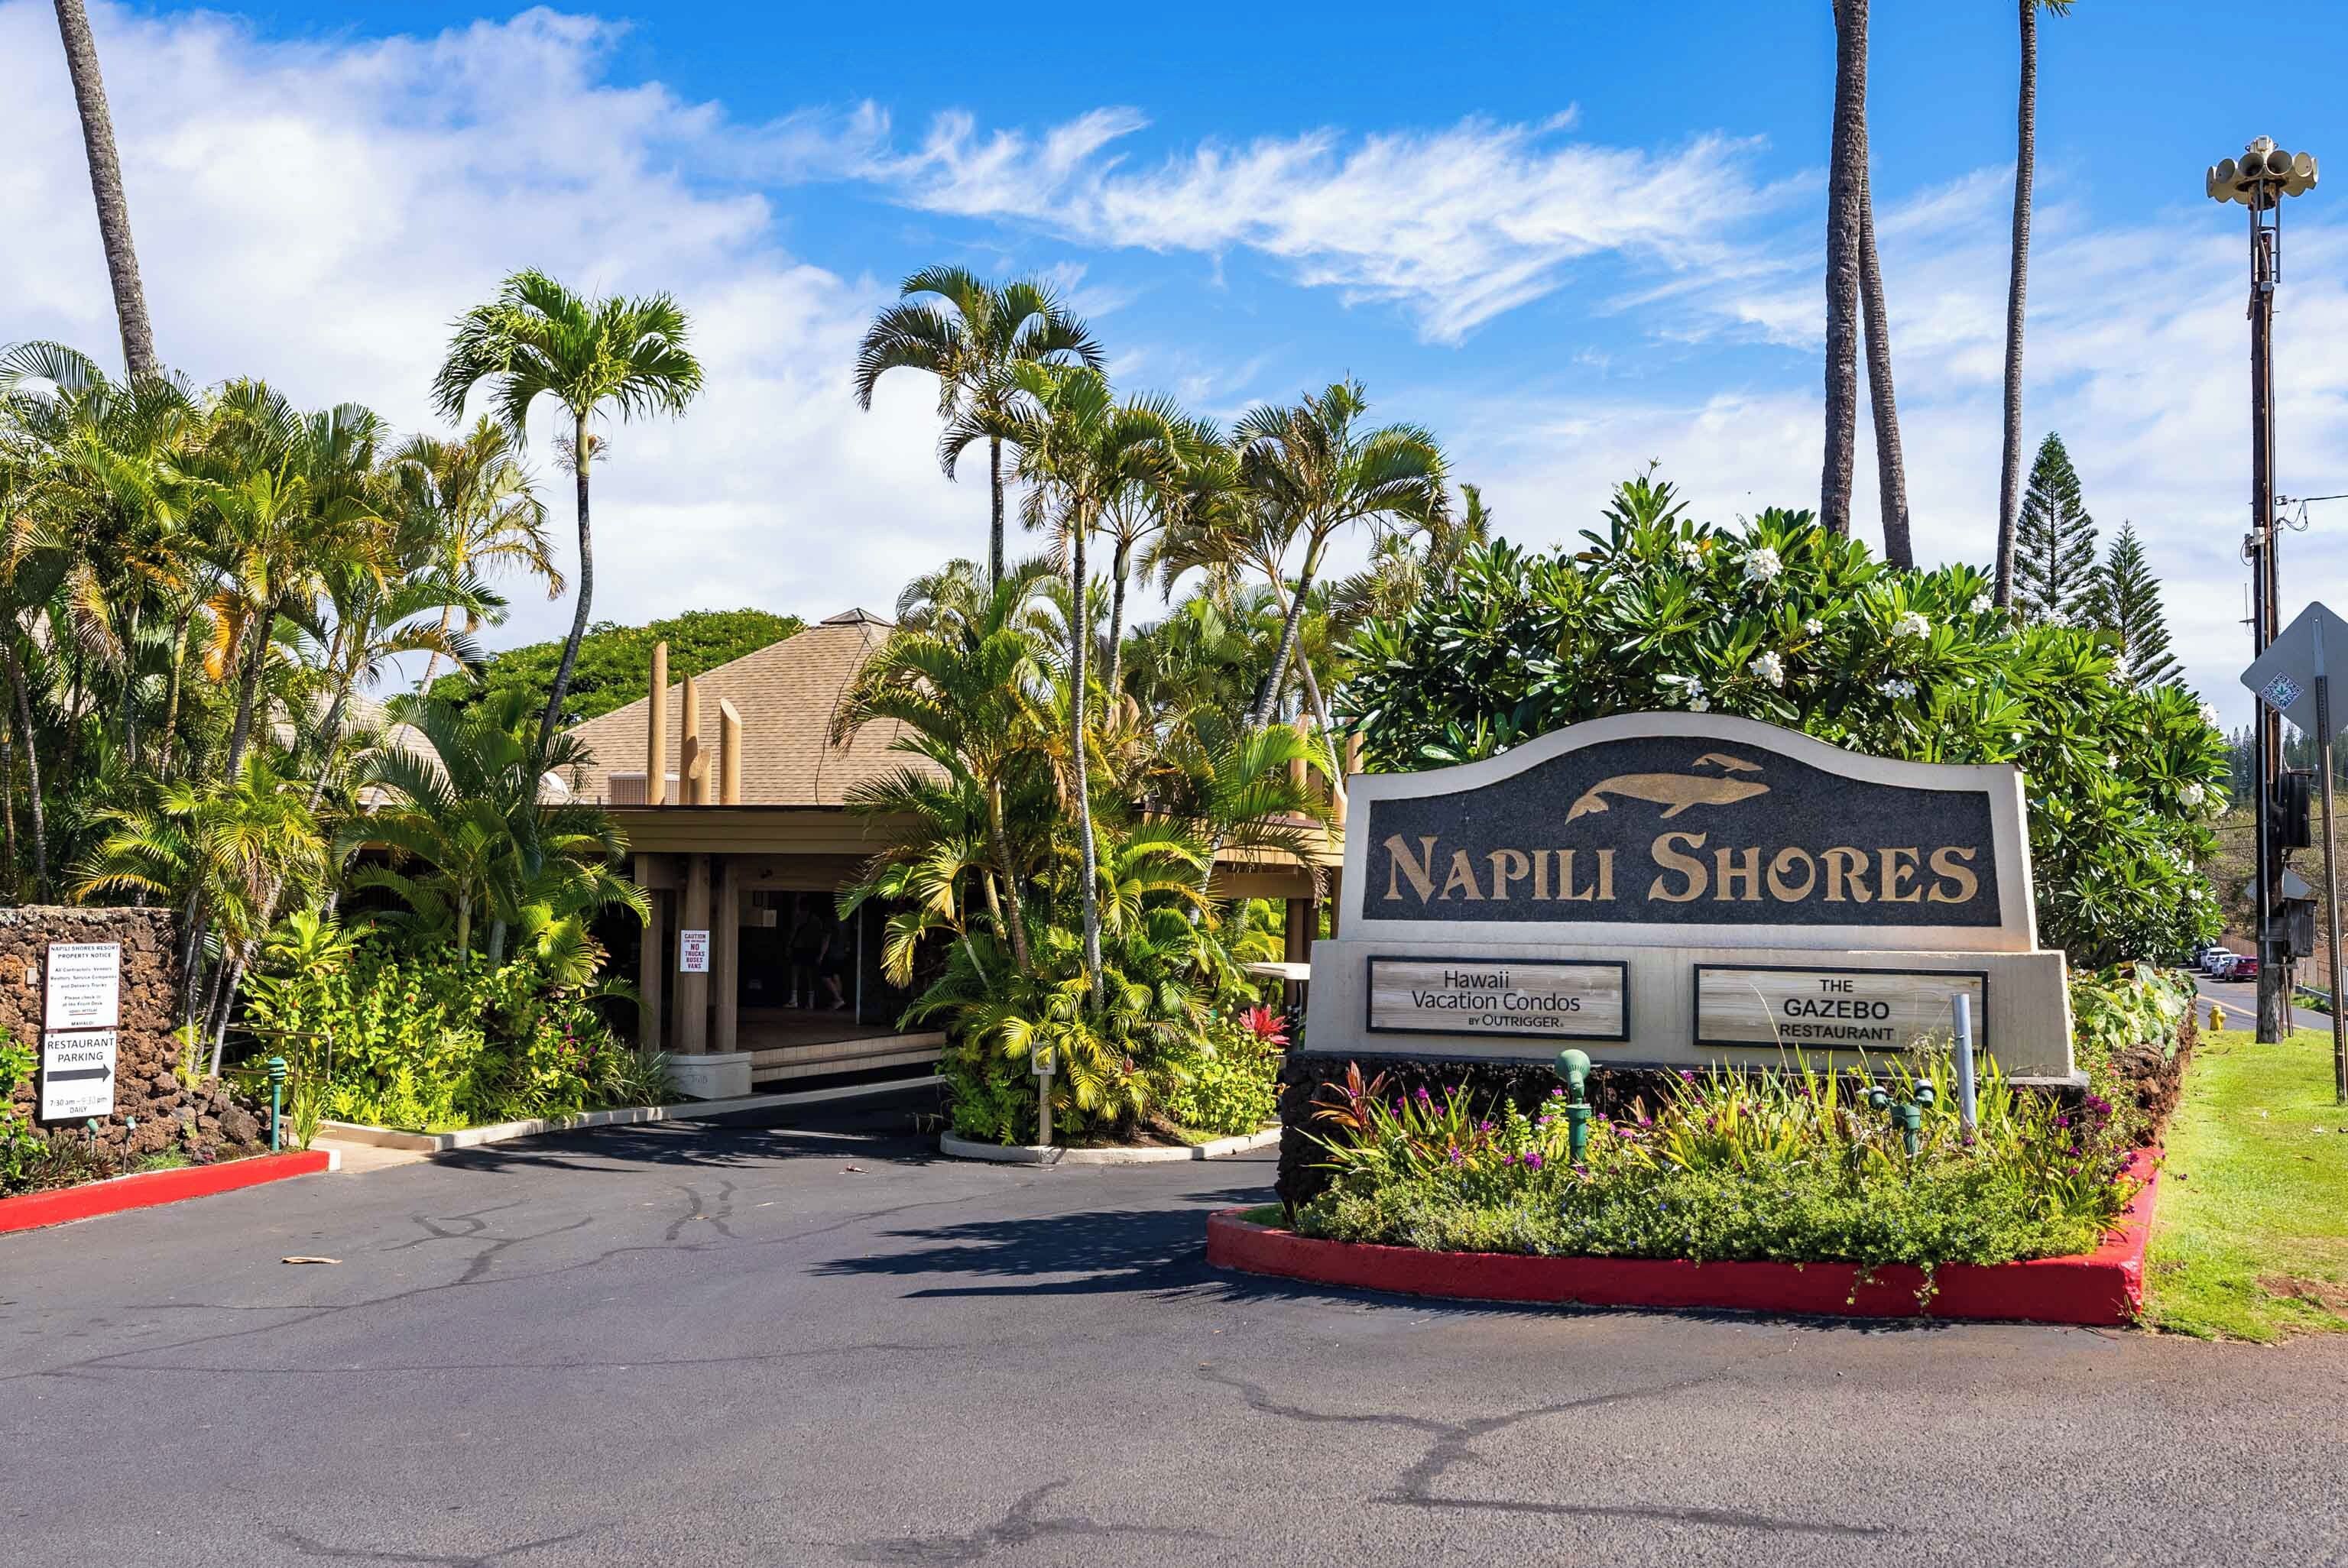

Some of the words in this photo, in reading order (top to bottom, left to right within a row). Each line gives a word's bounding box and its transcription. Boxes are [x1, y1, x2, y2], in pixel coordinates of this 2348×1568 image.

[1383, 833, 1616, 905] NAPILI
[1648, 831, 1978, 903] SHORES
[1445, 970, 1510, 989] Hawaii
[1820, 980, 1853, 992] THE
[1412, 990, 1497, 1009] Vacation
[1503, 993, 1581, 1011] Condos
[1784, 999, 1889, 1019] GAZEBO
[1468, 1017, 1480, 1025] BY
[1780, 1024, 1893, 1040] RESTAURANT
[47, 1038, 115, 1050] RESTAURANT
[58, 1051, 103, 1063] PARKING
